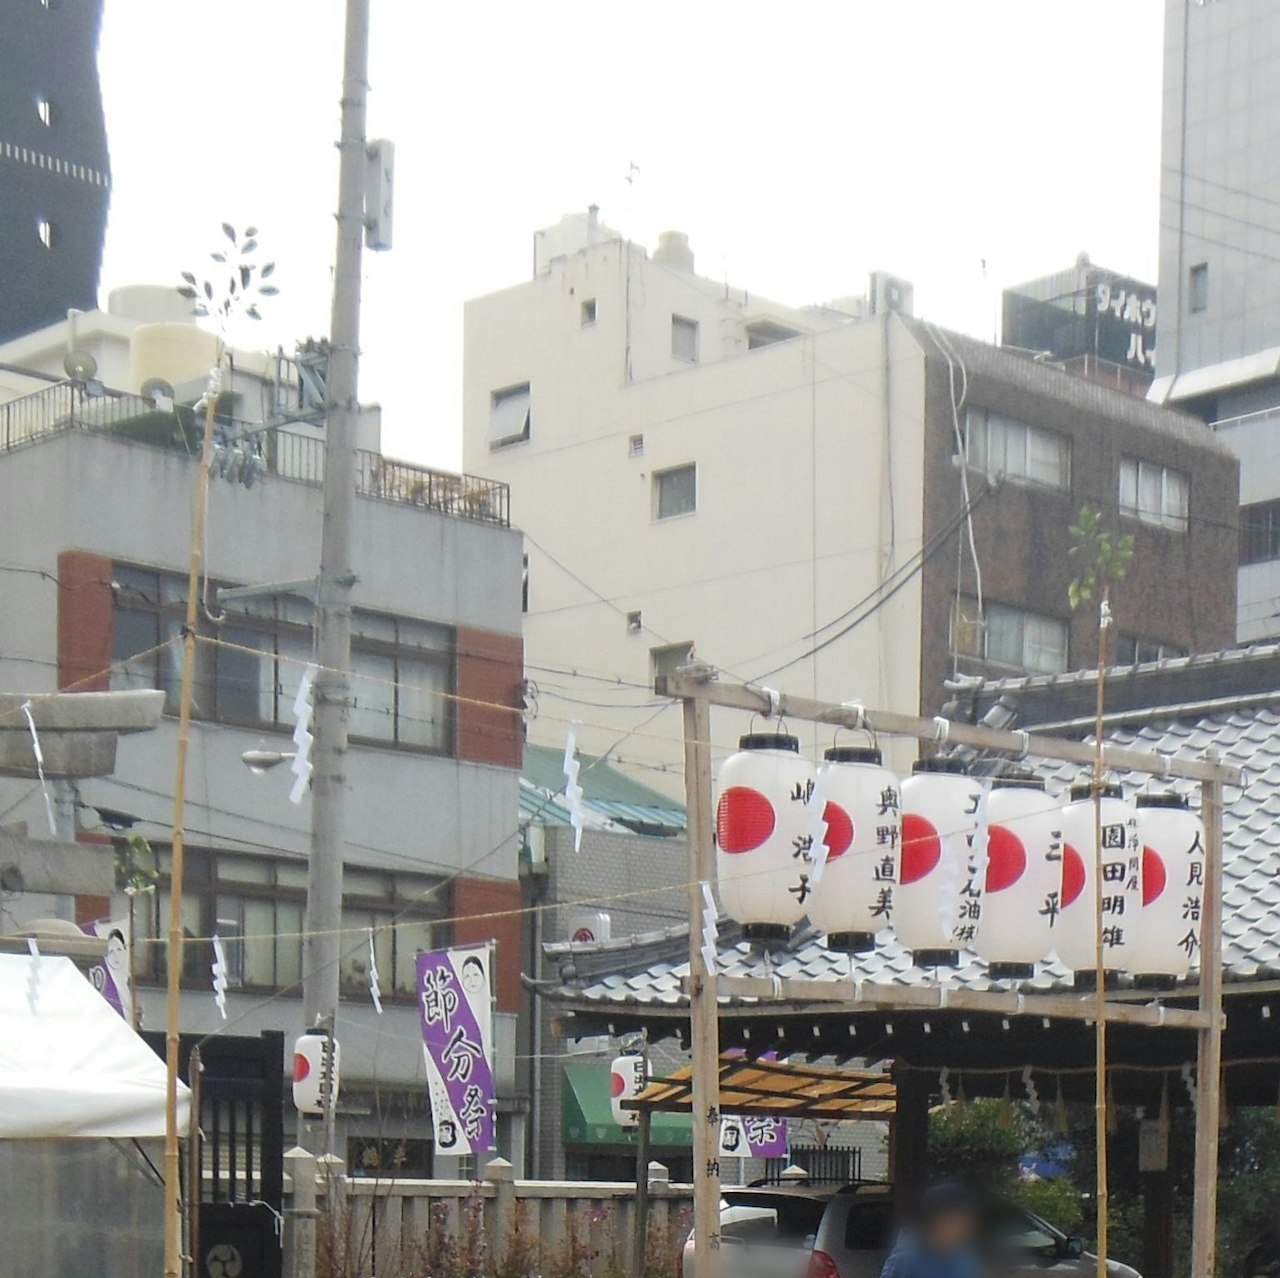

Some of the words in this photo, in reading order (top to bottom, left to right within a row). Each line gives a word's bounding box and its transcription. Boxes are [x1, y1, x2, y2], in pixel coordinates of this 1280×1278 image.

[868, 785, 899, 921] 奥野直美
[1177, 830, 1206, 959] 人見浩介
[422, 965, 488, 1142] 節分祭
